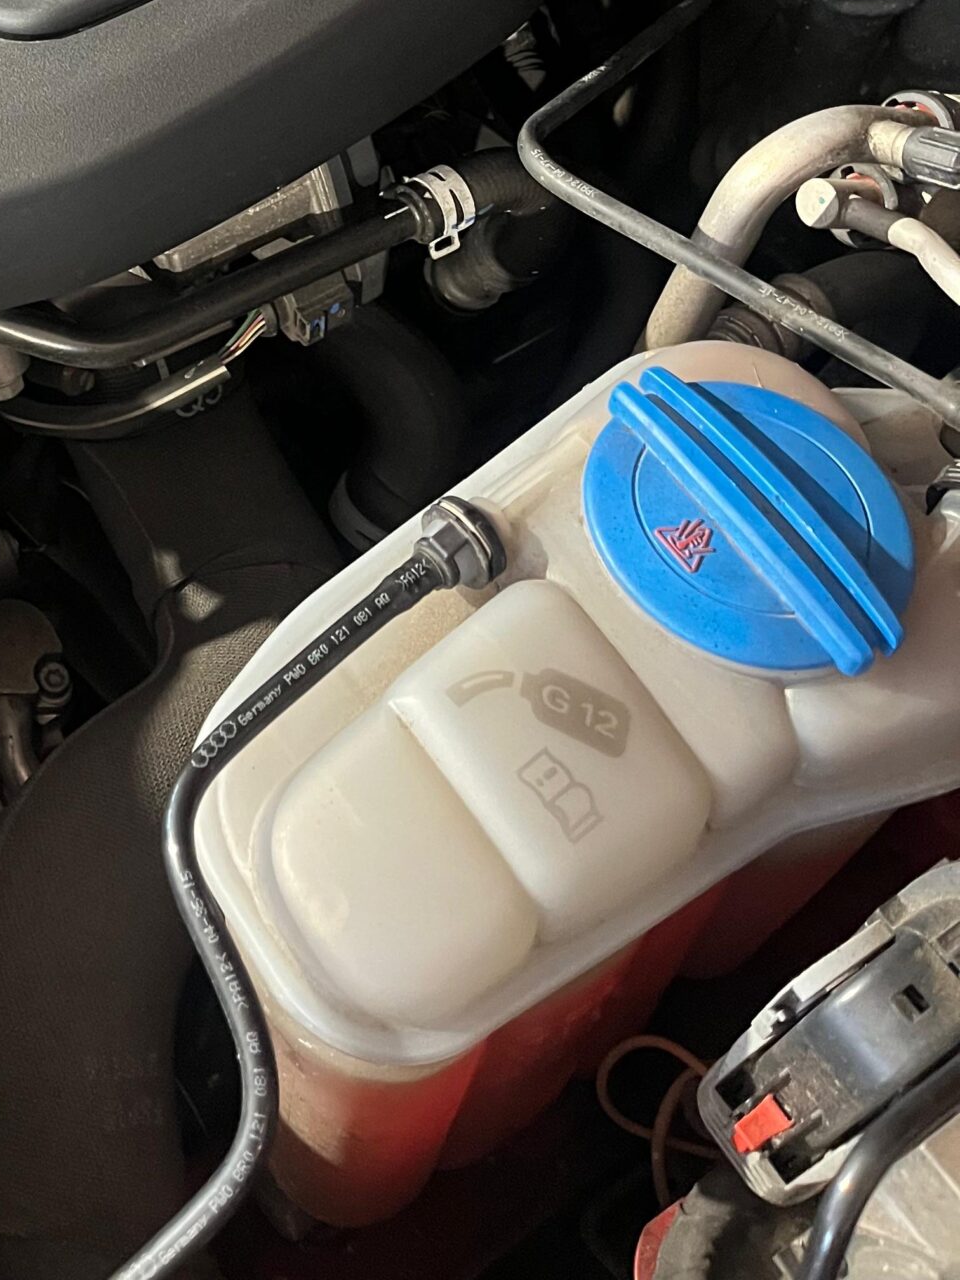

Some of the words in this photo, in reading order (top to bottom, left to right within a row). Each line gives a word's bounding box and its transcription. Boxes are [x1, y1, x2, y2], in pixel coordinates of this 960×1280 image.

[237, 683, 284, 727] Germany
[330, 626, 350, 646] 121
[540, 684, 571, 714] G
[579, 702, 620, 738] 12
